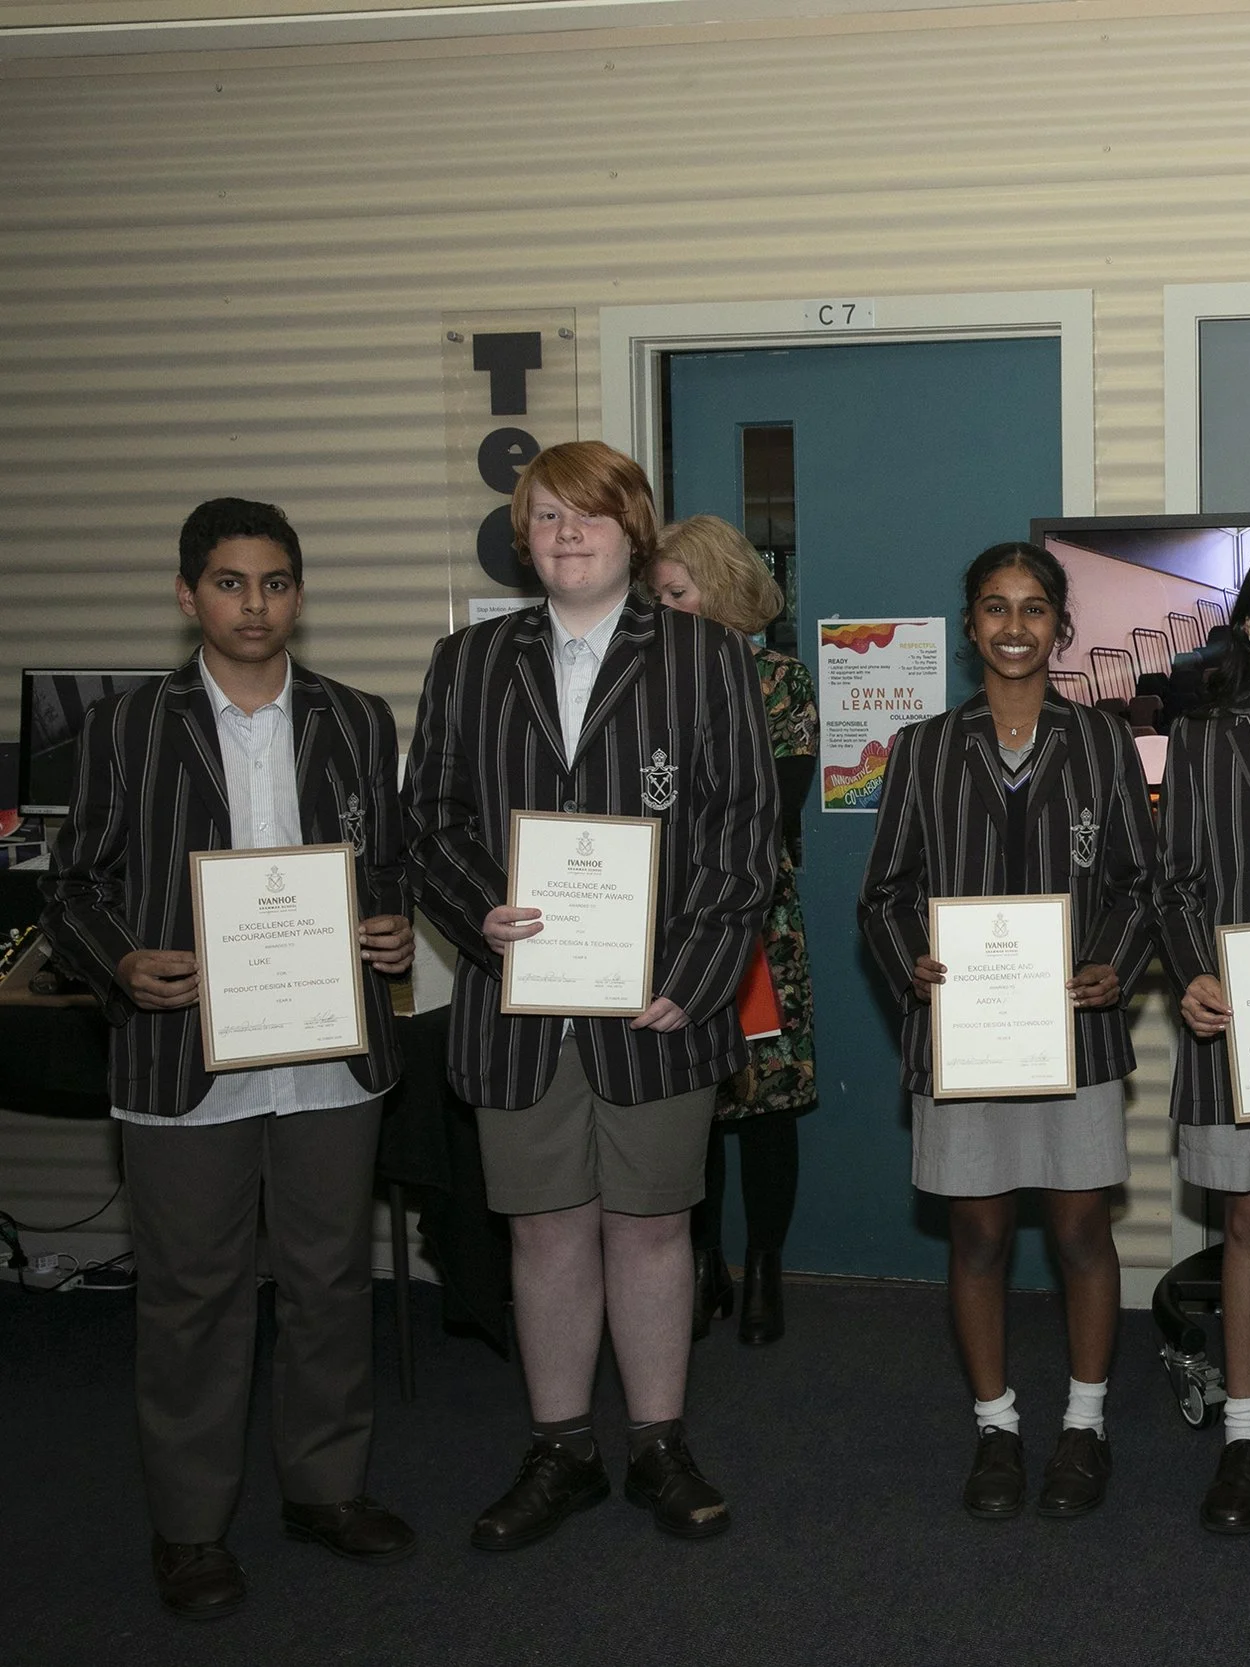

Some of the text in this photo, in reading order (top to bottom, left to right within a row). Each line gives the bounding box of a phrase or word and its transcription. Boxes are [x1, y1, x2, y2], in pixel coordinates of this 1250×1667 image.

[850, 688, 915, 699] OWN MY
[842, 700, 924, 710] LEARNING
[830, 757, 872, 787] INNOVATIVE
[845, 775, 884, 805] COLLABORA
[567, 859, 602, 867] IVANHOE
[547, 881, 598, 889] EXCELLENCE
[258, 895, 296, 905] IVANHOE
[531, 889, 633, 901] ENCOURAGEMENT AWARD
[545, 914, 580, 922] EDWARD
[238, 918, 314, 931] EXCELLENCE AND
[222, 926, 334, 942] ENCOURAGEMENT AWARD
[248, 957, 271, 966] LUKE
[223, 985, 257, 994] PRODUCT
[259, 982, 286, 991] DESIGN
[293, 977, 339, 987] TECHNOLOGY
